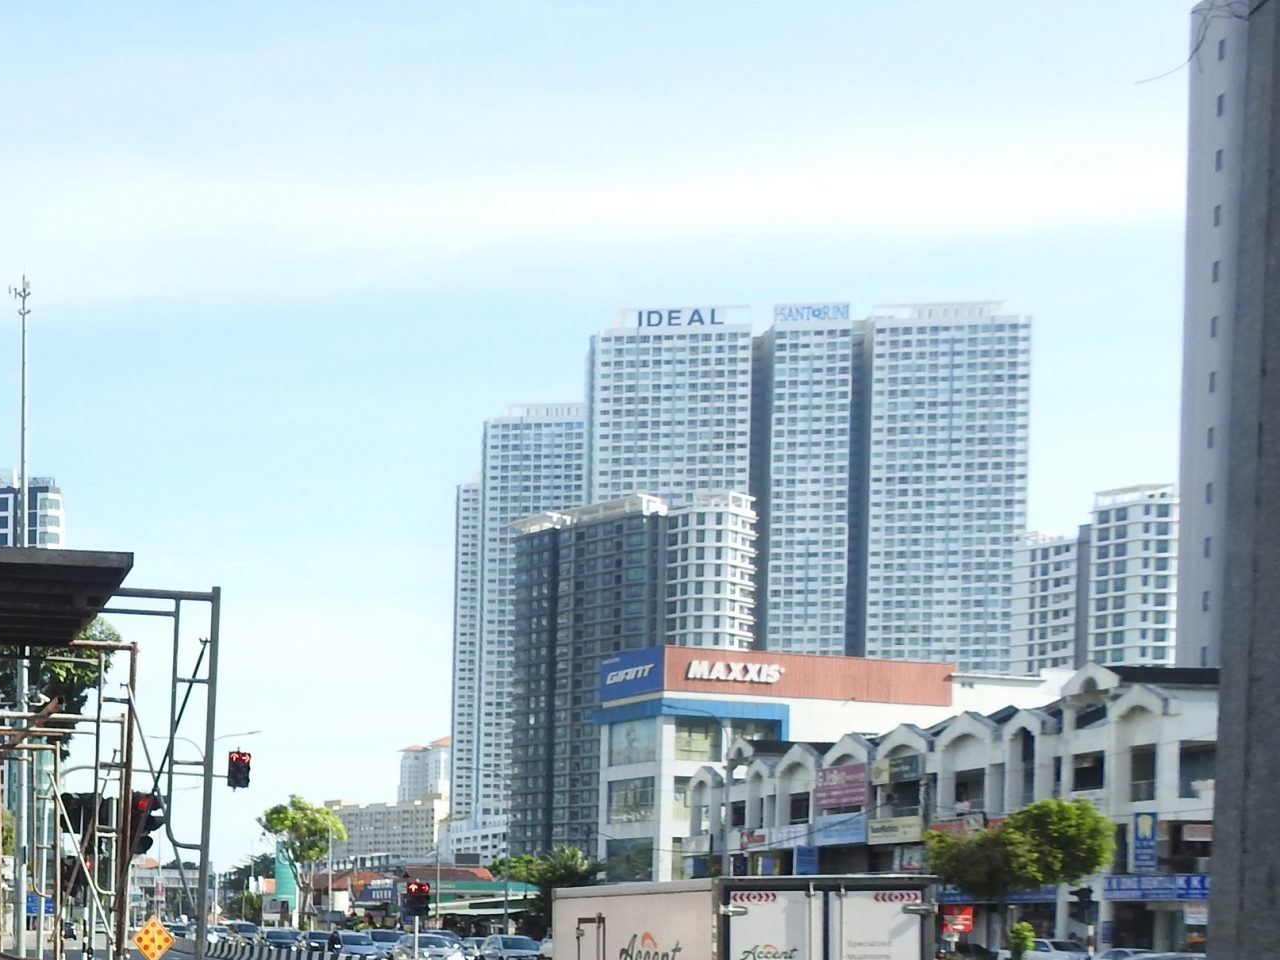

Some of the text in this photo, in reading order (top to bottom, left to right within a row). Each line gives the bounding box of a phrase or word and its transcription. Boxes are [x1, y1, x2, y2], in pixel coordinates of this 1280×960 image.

[637, 308, 725, 328] IDEAL
[605, 663, 656, 685] GIANT
[686, 659, 781, 684] MAXXIS
